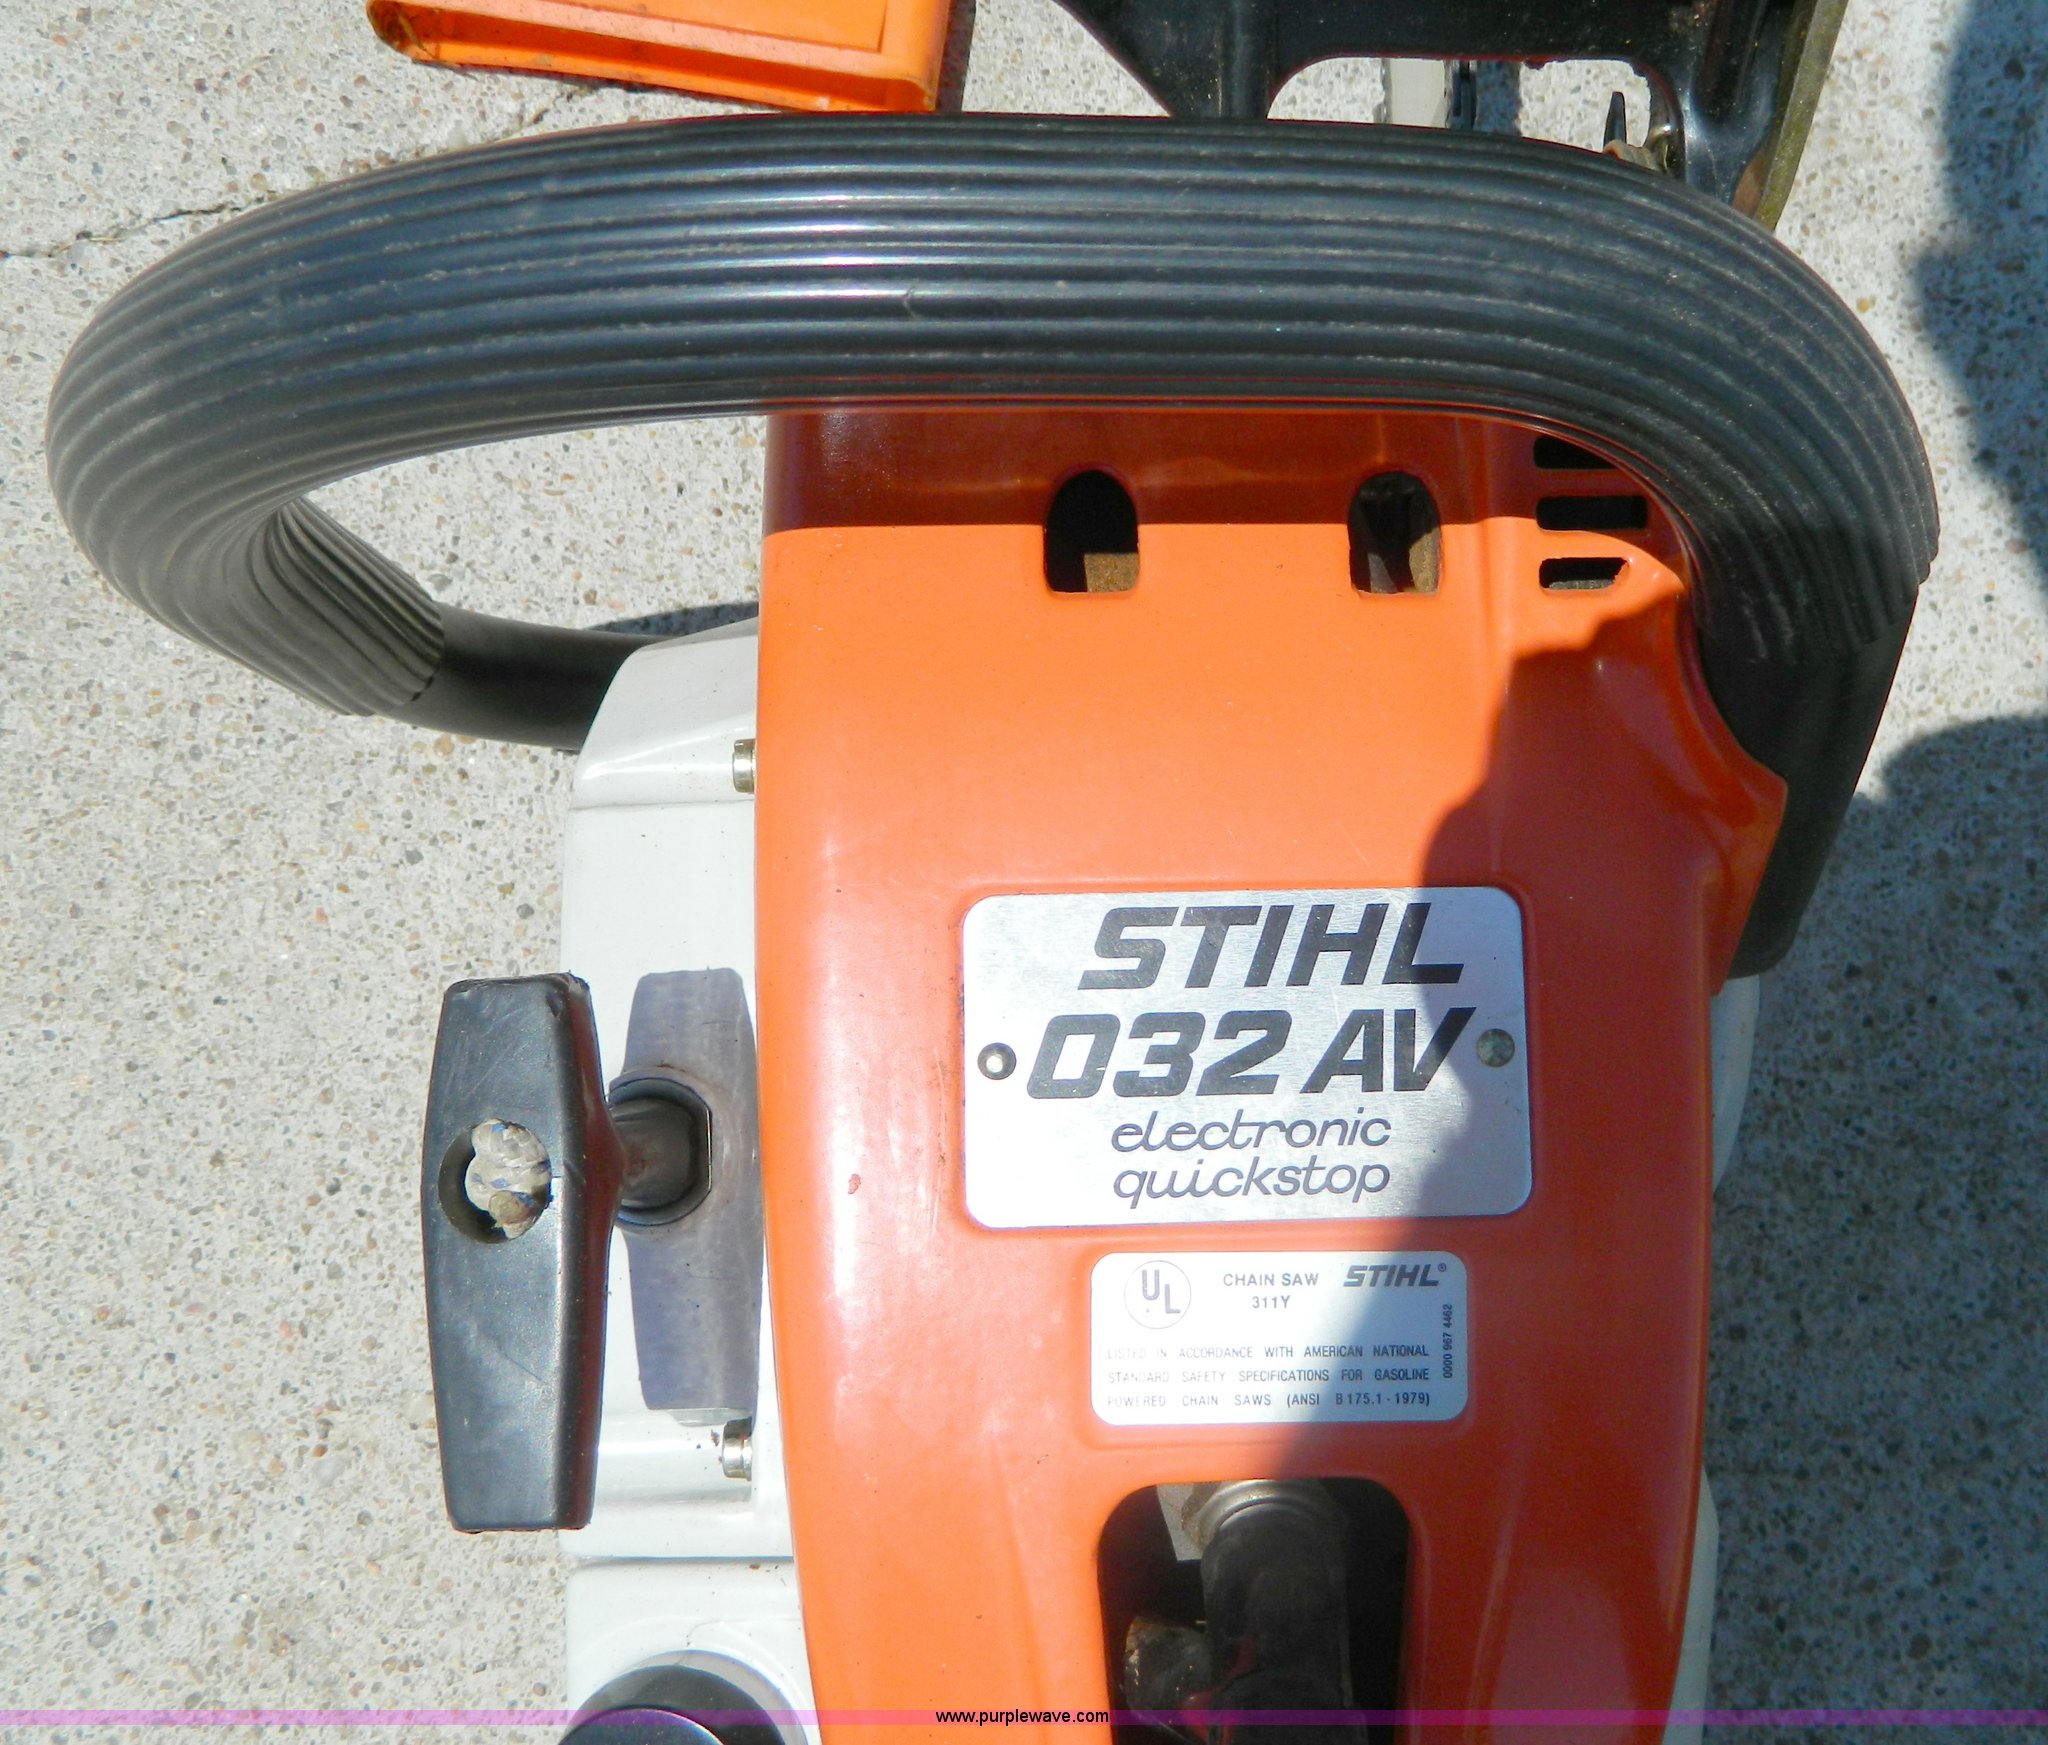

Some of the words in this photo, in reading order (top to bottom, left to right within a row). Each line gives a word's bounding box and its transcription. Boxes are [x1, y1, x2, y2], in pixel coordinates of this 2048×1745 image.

[1077, 902, 1464, 990] STIHL
[1026, 1009, 1293, 1099] 032
[1300, 1007, 1477, 1094] AV
[1111, 1106, 1392, 1153] electronic
[1113, 1154, 1391, 1210] quickstop
[1222, 1273, 1276, 1287] CHAIN
[1280, 1272, 1320, 1287] SAW
[1251, 1295, 1291, 1309] 311Y
[1442, 1303, 1453, 1329] 4462
[1107, 1347, 1147, 1360] LISTED
[1156, 1347, 1168, 1359] IN
[1178, 1346, 1254, 1359] ACCORDANCE
[1264, 1345, 1294, 1358] WITH
[1303, 1344, 1364, 1358] AMERICAN
[1372, 1344, 1430, 1358] NATIONAL
[1442, 1332, 1453, 1351] 967
[1107, 1370, 1170, 1384] STANDARD
[1181, 1369, 1226, 1383] SAFETY
[1238, 1369, 1329, 1382] SPECIFICATIONS
[1340, 1368, 1363, 1381] FOR
[1374, 1367, 1430, 1381] GASOLINE
[1442, 1353, 1453, 1379] 0000
[1107, 1394, 1167, 1408] POWERED
[1181, 1394, 1219, 1407] CHAIN
[1234, 1393, 1272, 1407] SAWS
[1286, 1392, 1320, 1408] (ANSI
